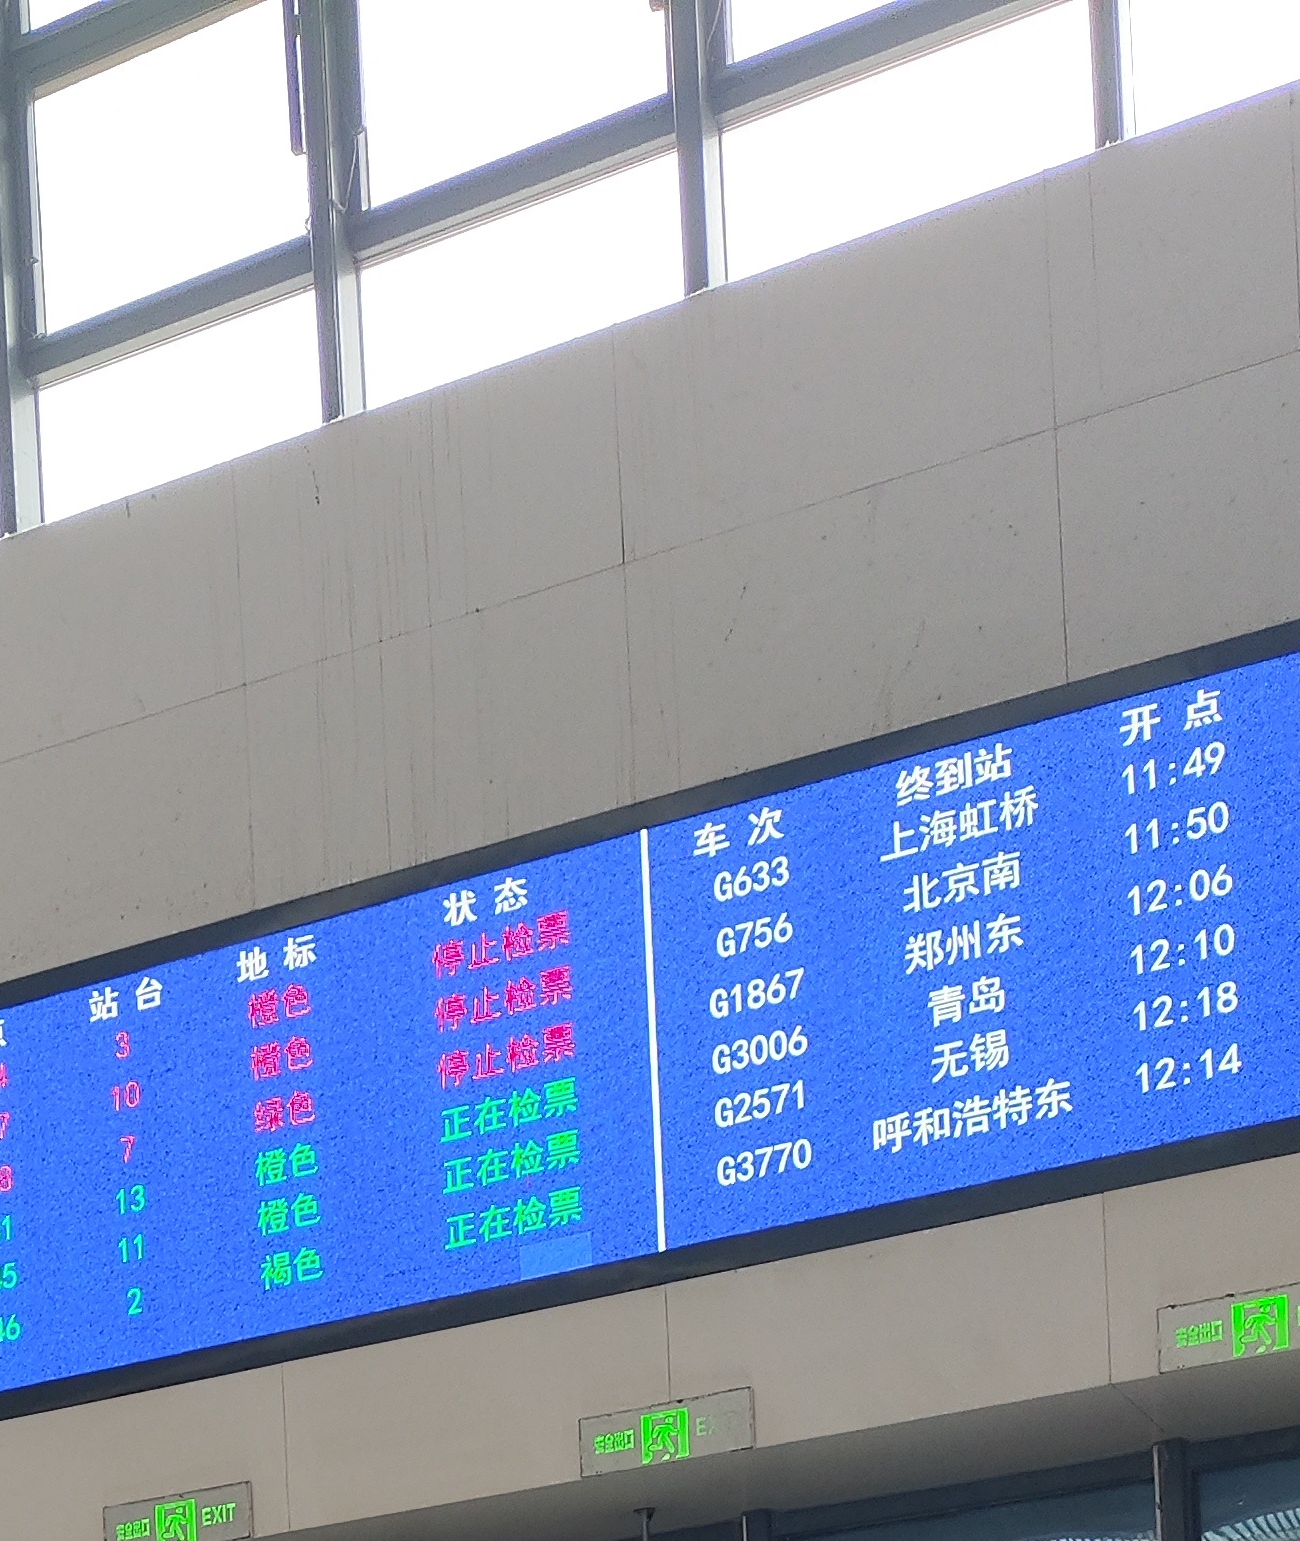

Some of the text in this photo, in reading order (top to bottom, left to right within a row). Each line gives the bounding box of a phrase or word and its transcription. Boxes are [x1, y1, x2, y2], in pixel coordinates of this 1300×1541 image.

[694, 689, 1225, 861] 车次 终到站 开点
[712, 740, 1225, 901] G633 上海虹桥 11:49
[89, 977, 162, 1022] 站台
[237, 935, 316, 985] 地标
[443, 877, 529, 928] 状态
[710, 864, 1232, 1018] G1867 郑州东 12:06
[717, 802, 1229, 957] G756 北京南 11:50
[111, 1082, 140, 1111] 10
[434, 964, 574, 1034] 停止检票
[116, 1032, 130, 1059] 3
[432, 909, 571, 980] 停止检票
[712, 924, 1235, 1074] G3006 青岛 12:10
[715, 981, 1238, 1127] G2571 无锡 12:18
[116, 1185, 144, 1214] 13
[255, 1143, 318, 1186] 橙色
[441, 1075, 578, 1145] 正在检票
[120, 1136, 135, 1163] 7
[437, 1021, 575, 1090] 停止检票
[717, 1044, 1242, 1186] G3770 呼和浩特东 12:14
[119, 1234, 142, 1262] 11
[258, 1193, 320, 1236] 橙色
[441, 1128, 580, 1197] 正在检票
[128, 1288, 142, 1314] 2
[261, 1247, 323, 1290] 褐色
[443, 1185, 582, 1249] 正在检票
[1175, 1320, 1223, 1349] 安全出口
[201, 1502, 236, 1527] EXIT
